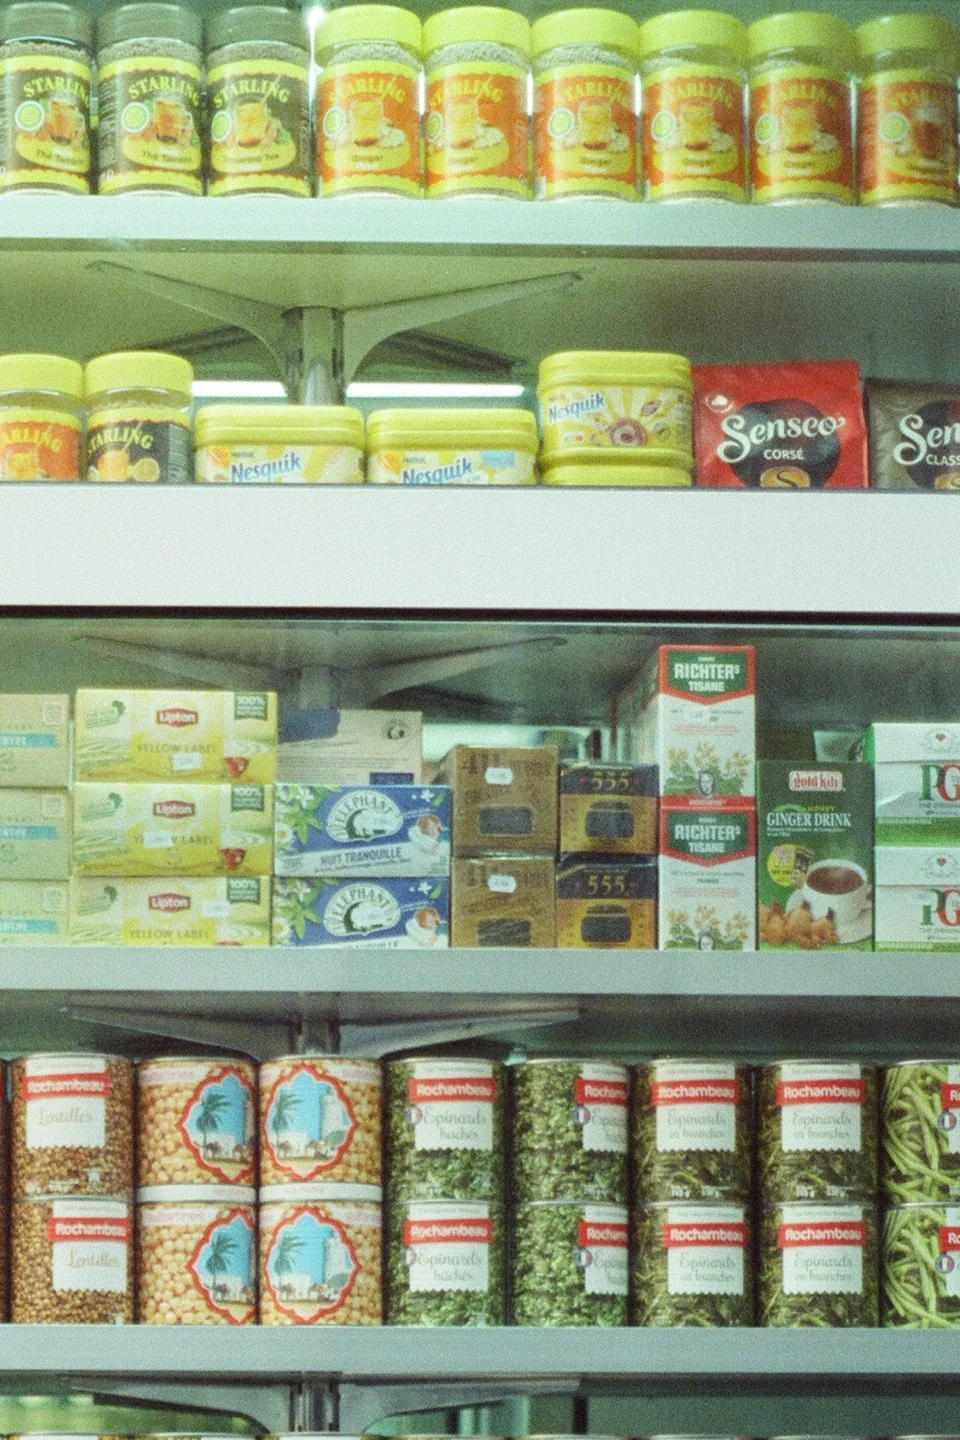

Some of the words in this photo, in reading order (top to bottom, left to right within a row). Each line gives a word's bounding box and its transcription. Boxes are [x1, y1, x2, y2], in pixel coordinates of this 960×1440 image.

[214, 74, 290, 107] STARLING
[548, 393, 605, 422] Nesquik
[717, 414, 848, 464] Senseo
[764, 445, 804, 460] CORSÉ
[231, 452, 301, 483] Nesquik
[403, 457, 472, 485] Nesquik
[688, 682, 725, 693] TISANE
[159, 711, 197, 726] Lipton
[156, 802, 193, 818] Lipton
[766, 812, 812, 829] GINGER
[814, 812, 852, 829] DRINK
[150, 894, 189, 911] Lipton
[659, 1084, 736, 1099] Rochambeau
[783, 1085, 860, 1099] Rochambeau
[785, 1228, 862, 1242] Rochambeau
